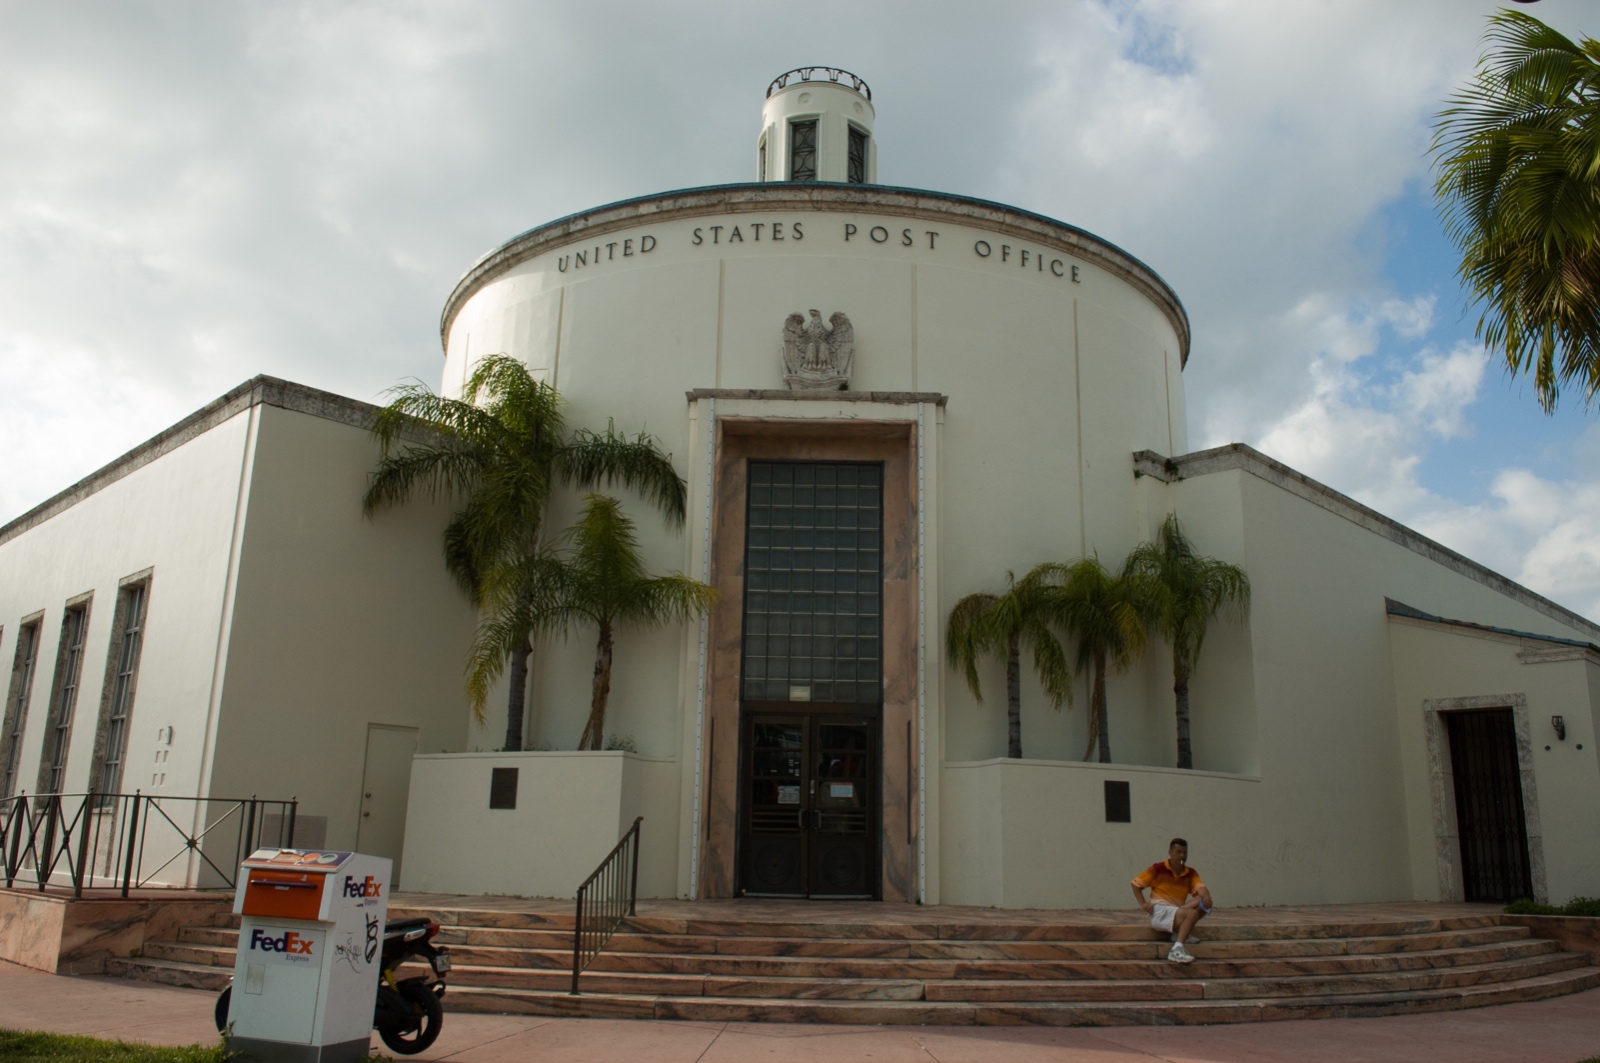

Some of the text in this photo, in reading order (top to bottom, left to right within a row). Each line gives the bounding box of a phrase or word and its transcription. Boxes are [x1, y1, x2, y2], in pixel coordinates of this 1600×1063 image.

[558, 222, 1081, 284] UNITED STATES POST OFFICE
[343, 875, 382, 898] FedEx
[250, 929, 314, 955] FedEx
[286, 954, 310, 963] Express
